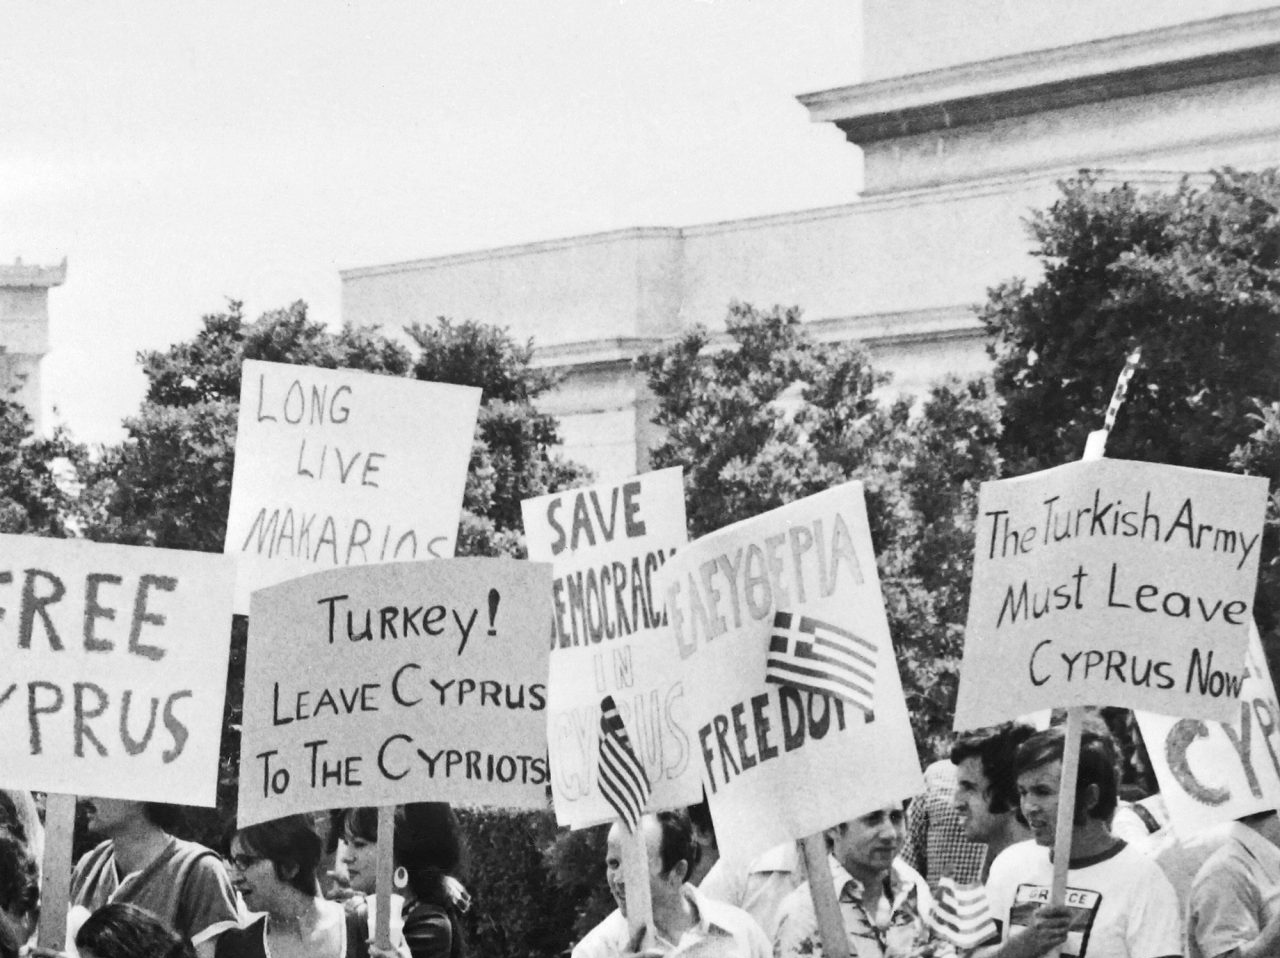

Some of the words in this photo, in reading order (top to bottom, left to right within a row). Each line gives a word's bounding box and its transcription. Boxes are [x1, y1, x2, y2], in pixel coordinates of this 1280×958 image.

[257, 374, 352, 424] LONG
[297, 438, 387, 488] LIVE
[547, 481, 646, 556] SAVE
[985, 510, 1036, 559] The
[1043, 488, 1161, 546] Turkish
[1164, 498, 1260, 570] Army
[996, 565, 1089, 629] Must
[1108, 563, 1248, 625] Leave
[594, 645, 634, 692] IN
[1029, 639, 1176, 690] CYPRUS
[273, 682, 381, 726] LEAVE
[391, 663, 547, 711] CYPRUS
[304, 740, 363, 788] THE
[553, 681, 690, 802] CYUS
[1028, 889, 1088, 905] GRCE
